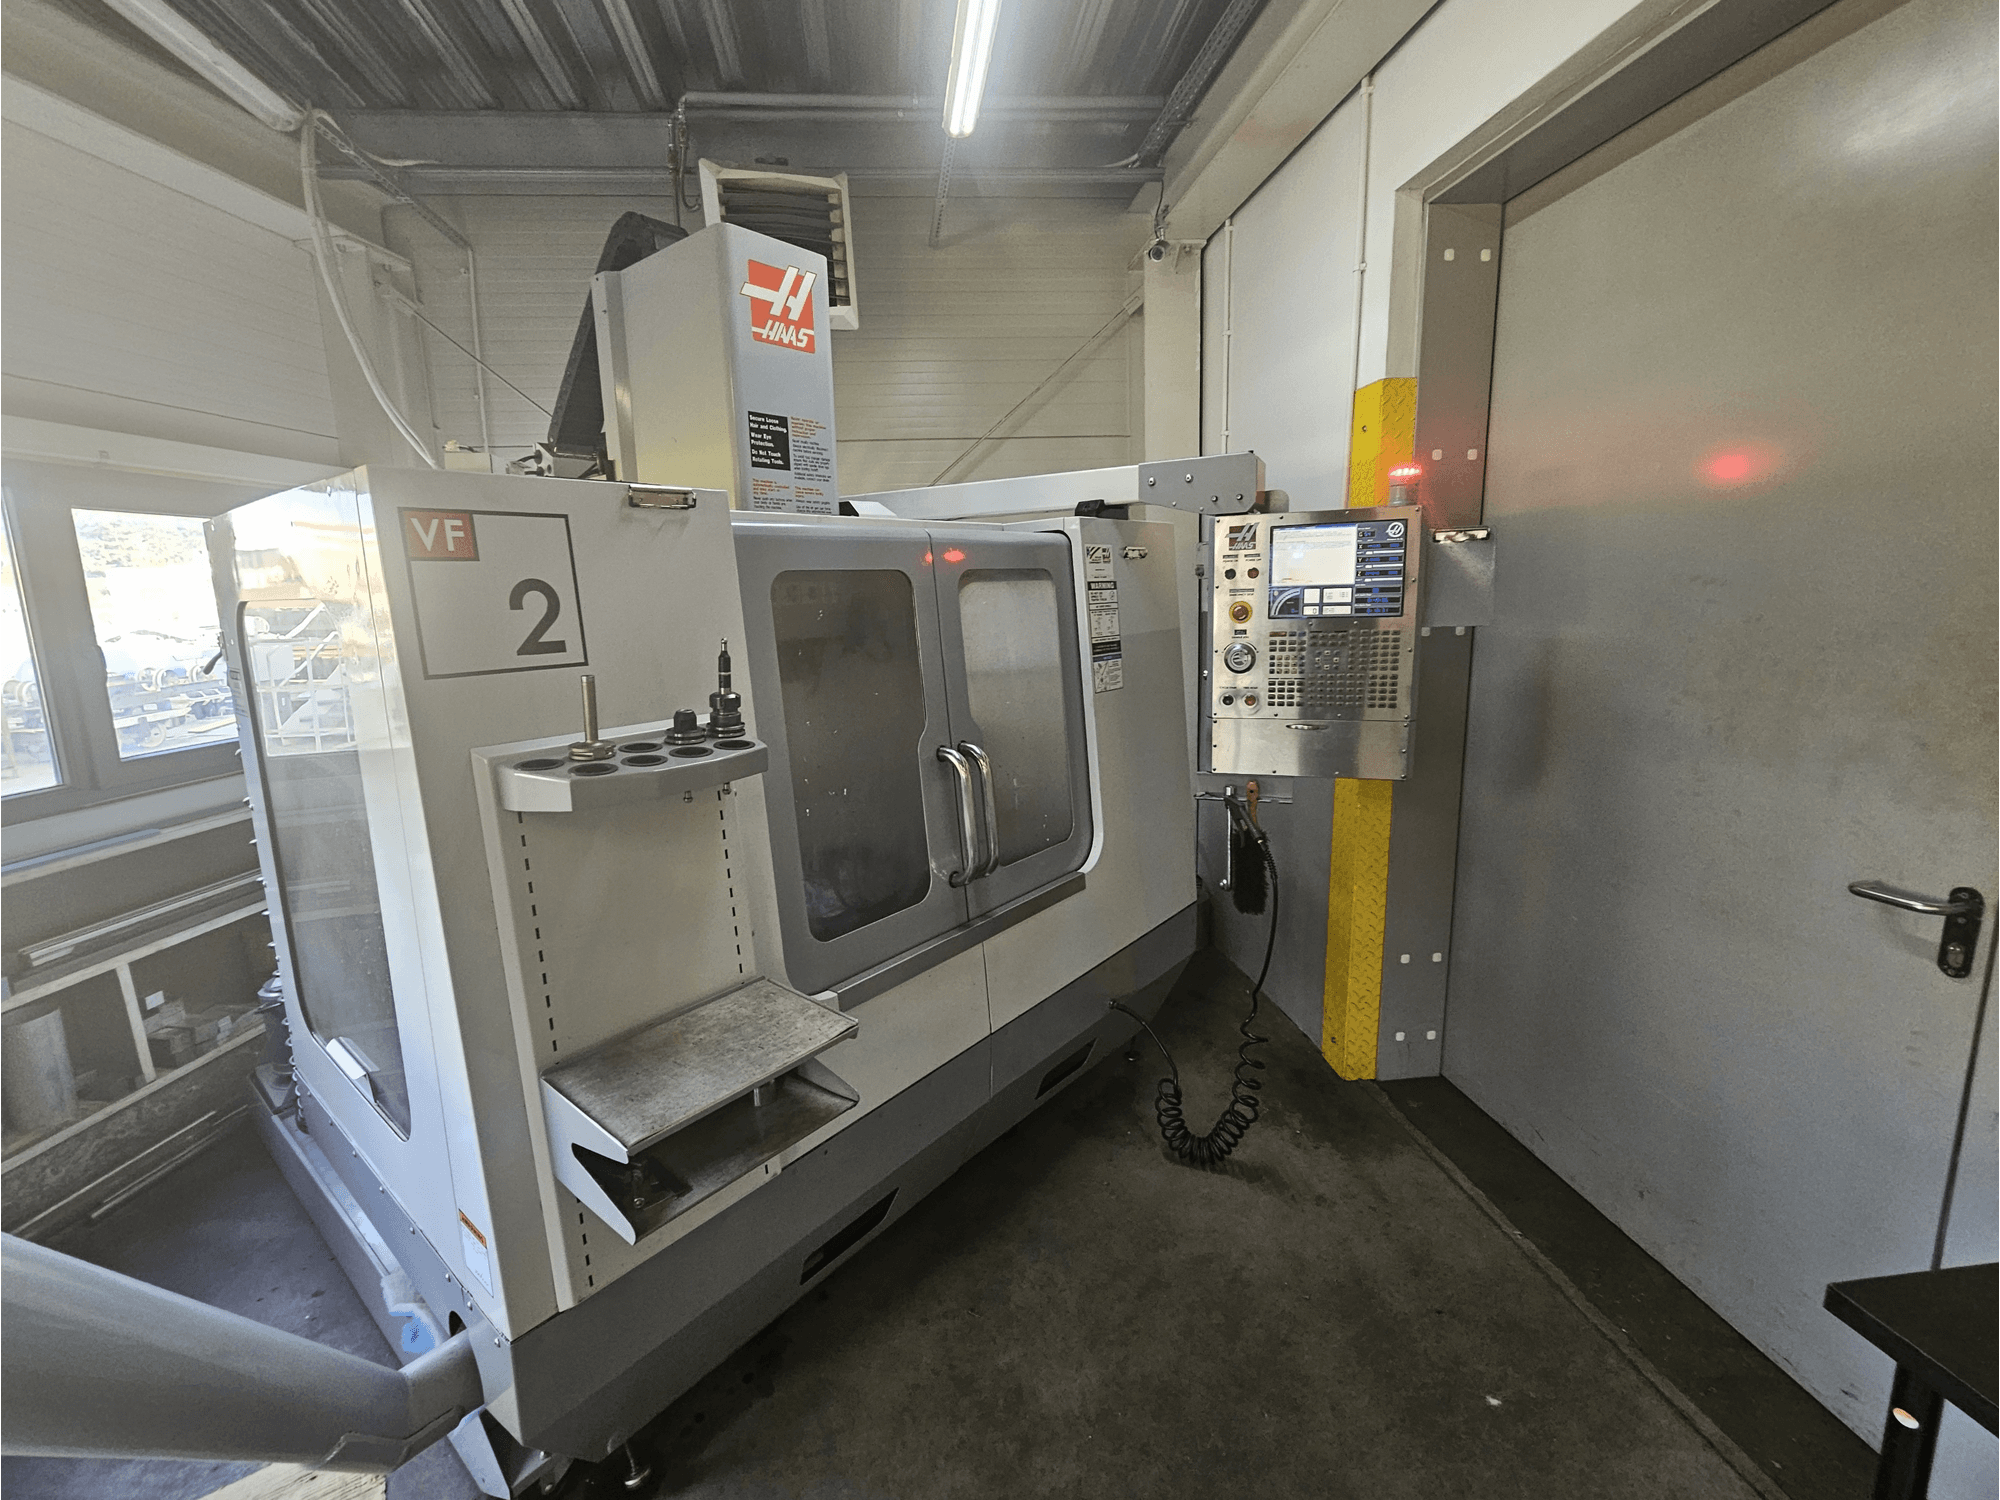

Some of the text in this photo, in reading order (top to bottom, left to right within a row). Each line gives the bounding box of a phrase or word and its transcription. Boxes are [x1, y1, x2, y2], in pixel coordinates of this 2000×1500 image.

[752, 319, 814, 348] HAAS
[411, 518, 465, 552] VF
[509, 578, 567, 656] 2
